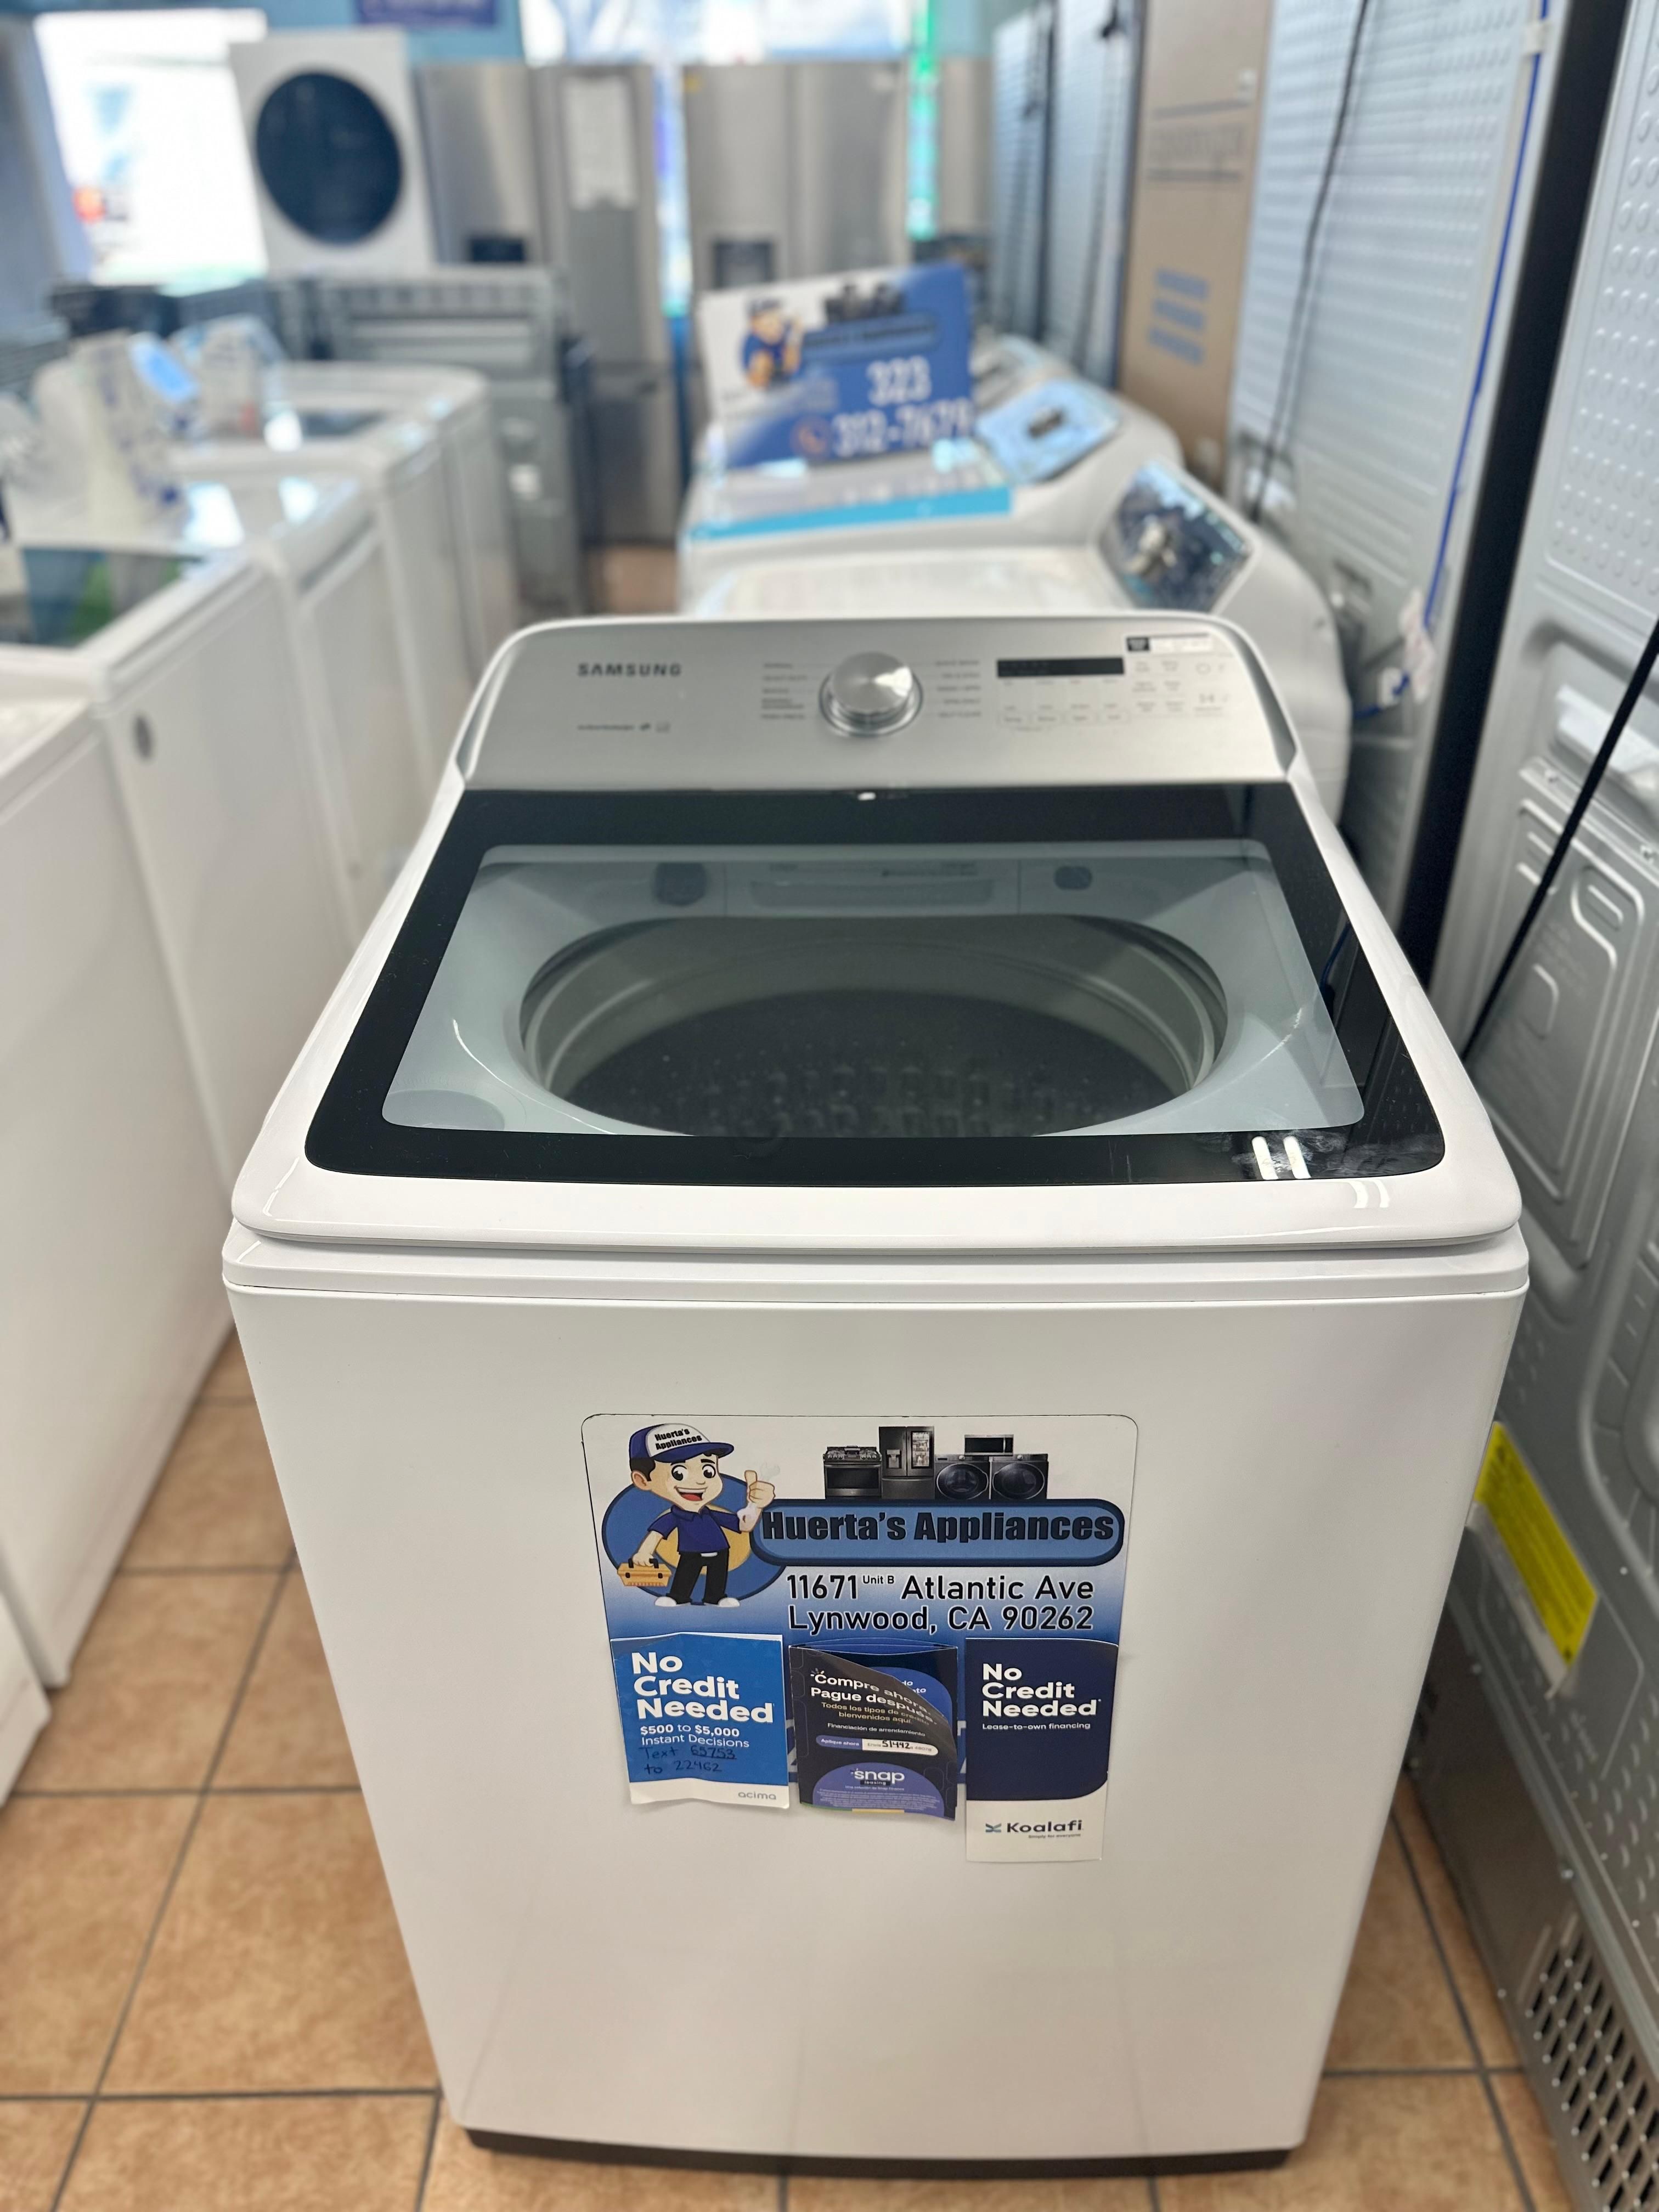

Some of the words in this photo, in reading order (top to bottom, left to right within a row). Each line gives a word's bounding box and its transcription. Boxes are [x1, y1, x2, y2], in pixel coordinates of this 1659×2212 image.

[867, 357, 931, 405] 323
[578, 662, 682, 677] SAMSUNG
[654, 1429, 690, 1441] Huerta's
[655, 1435, 702, 1450] Appliances
[762, 1511, 906, 1541] Huerta's
[913, 1513, 1114, 1543] Appliances
[787, 1575, 857, 1599] 11671
[863, 1575, 884, 1584] Unit
[887, 1575, 894, 1584] B
[901, 1575, 1024, 1600] Atlantic
[1035, 1575, 1094, 1600] Ave
[789, 1605, 937, 1635] Lynwood,
[948, 1605, 991, 1630] CA
[1002, 1605, 1093, 1630] 90262
[631, 1652, 683, 1674] No
[983, 1663, 1022, 1680] No
[634, 1675, 740, 1700] Credit
[811, 1687, 861, 1701] Pague
[815, 1673, 879, 1692] Compre
[884, 1689, 931, 1715] ahora.
[982, 1681, 1075, 1699] Credit
[636, 1697, 774, 1723] Needed
[821, 1702, 847, 1710] Todos
[839, 1711, 890, 1721] bienvenidos
[640, 1724, 674, 1735] $500
[695, 1724, 740, 1737] $5,000
[827, 1723, 867, 1731] Financiación
[1048, 1722, 1091, 1730] financing
[641, 1734, 685, 1745] Instant
[688, 1734, 749, 1748] Decisions
[639, 1746, 679, 1759] Text
[644, 1764, 663, 1775] to
[854, 1771, 905, 1784] snap
[738, 1791, 776, 1800] acima
[1007, 1820, 1082, 1833] Koalafi
